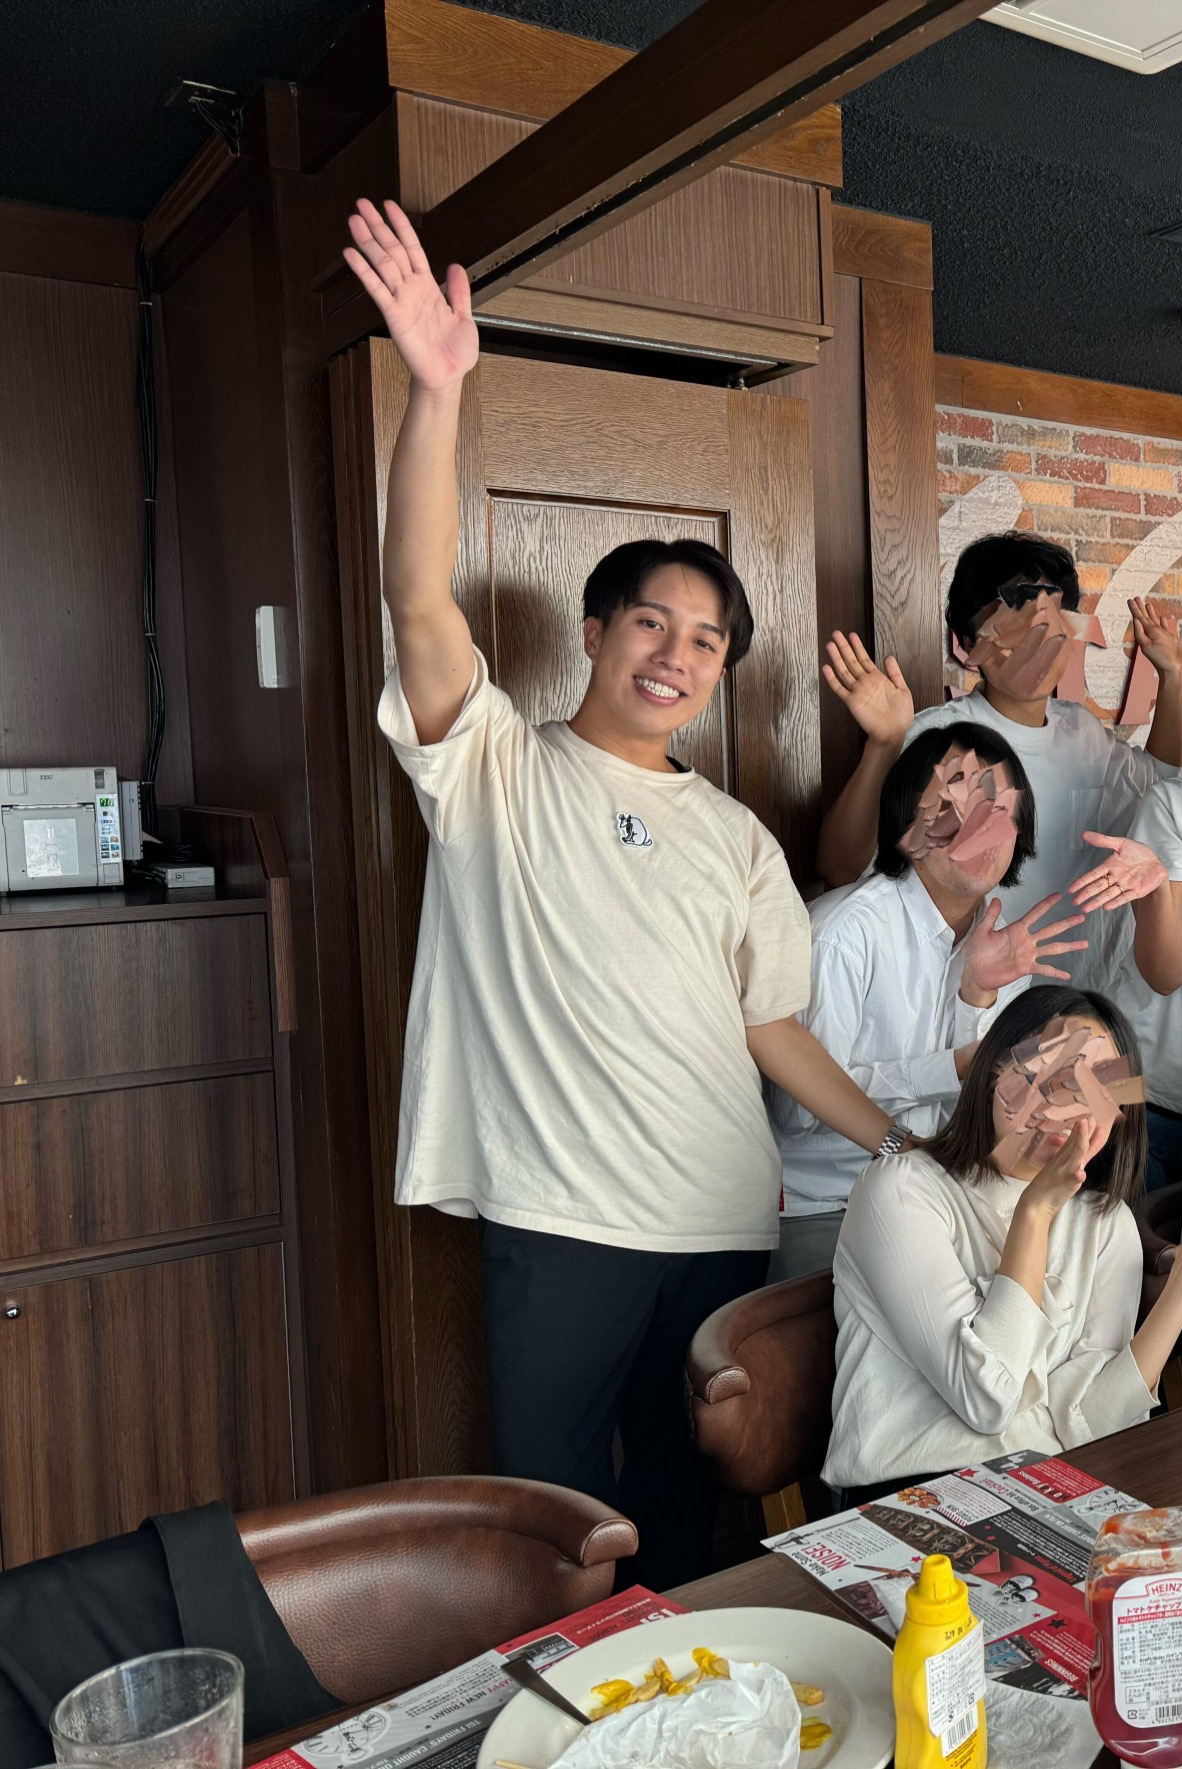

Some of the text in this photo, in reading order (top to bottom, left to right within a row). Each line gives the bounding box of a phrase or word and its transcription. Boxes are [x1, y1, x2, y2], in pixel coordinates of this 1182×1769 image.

[791, 1551, 830, 1576] Make Some
[801, 1543, 851, 1571] NOISE!
[1151, 1583, 1182, 1595] HEINZ
[1127, 1601, 1182, 1615] トマトケチャップ
[465, 1689, 488, 1707] NEW
[429, 1699, 467, 1721] FRIDAY!
[465, 1718, 481, 1730] TGI
[392, 1741, 428, 1760] CAUGHT
